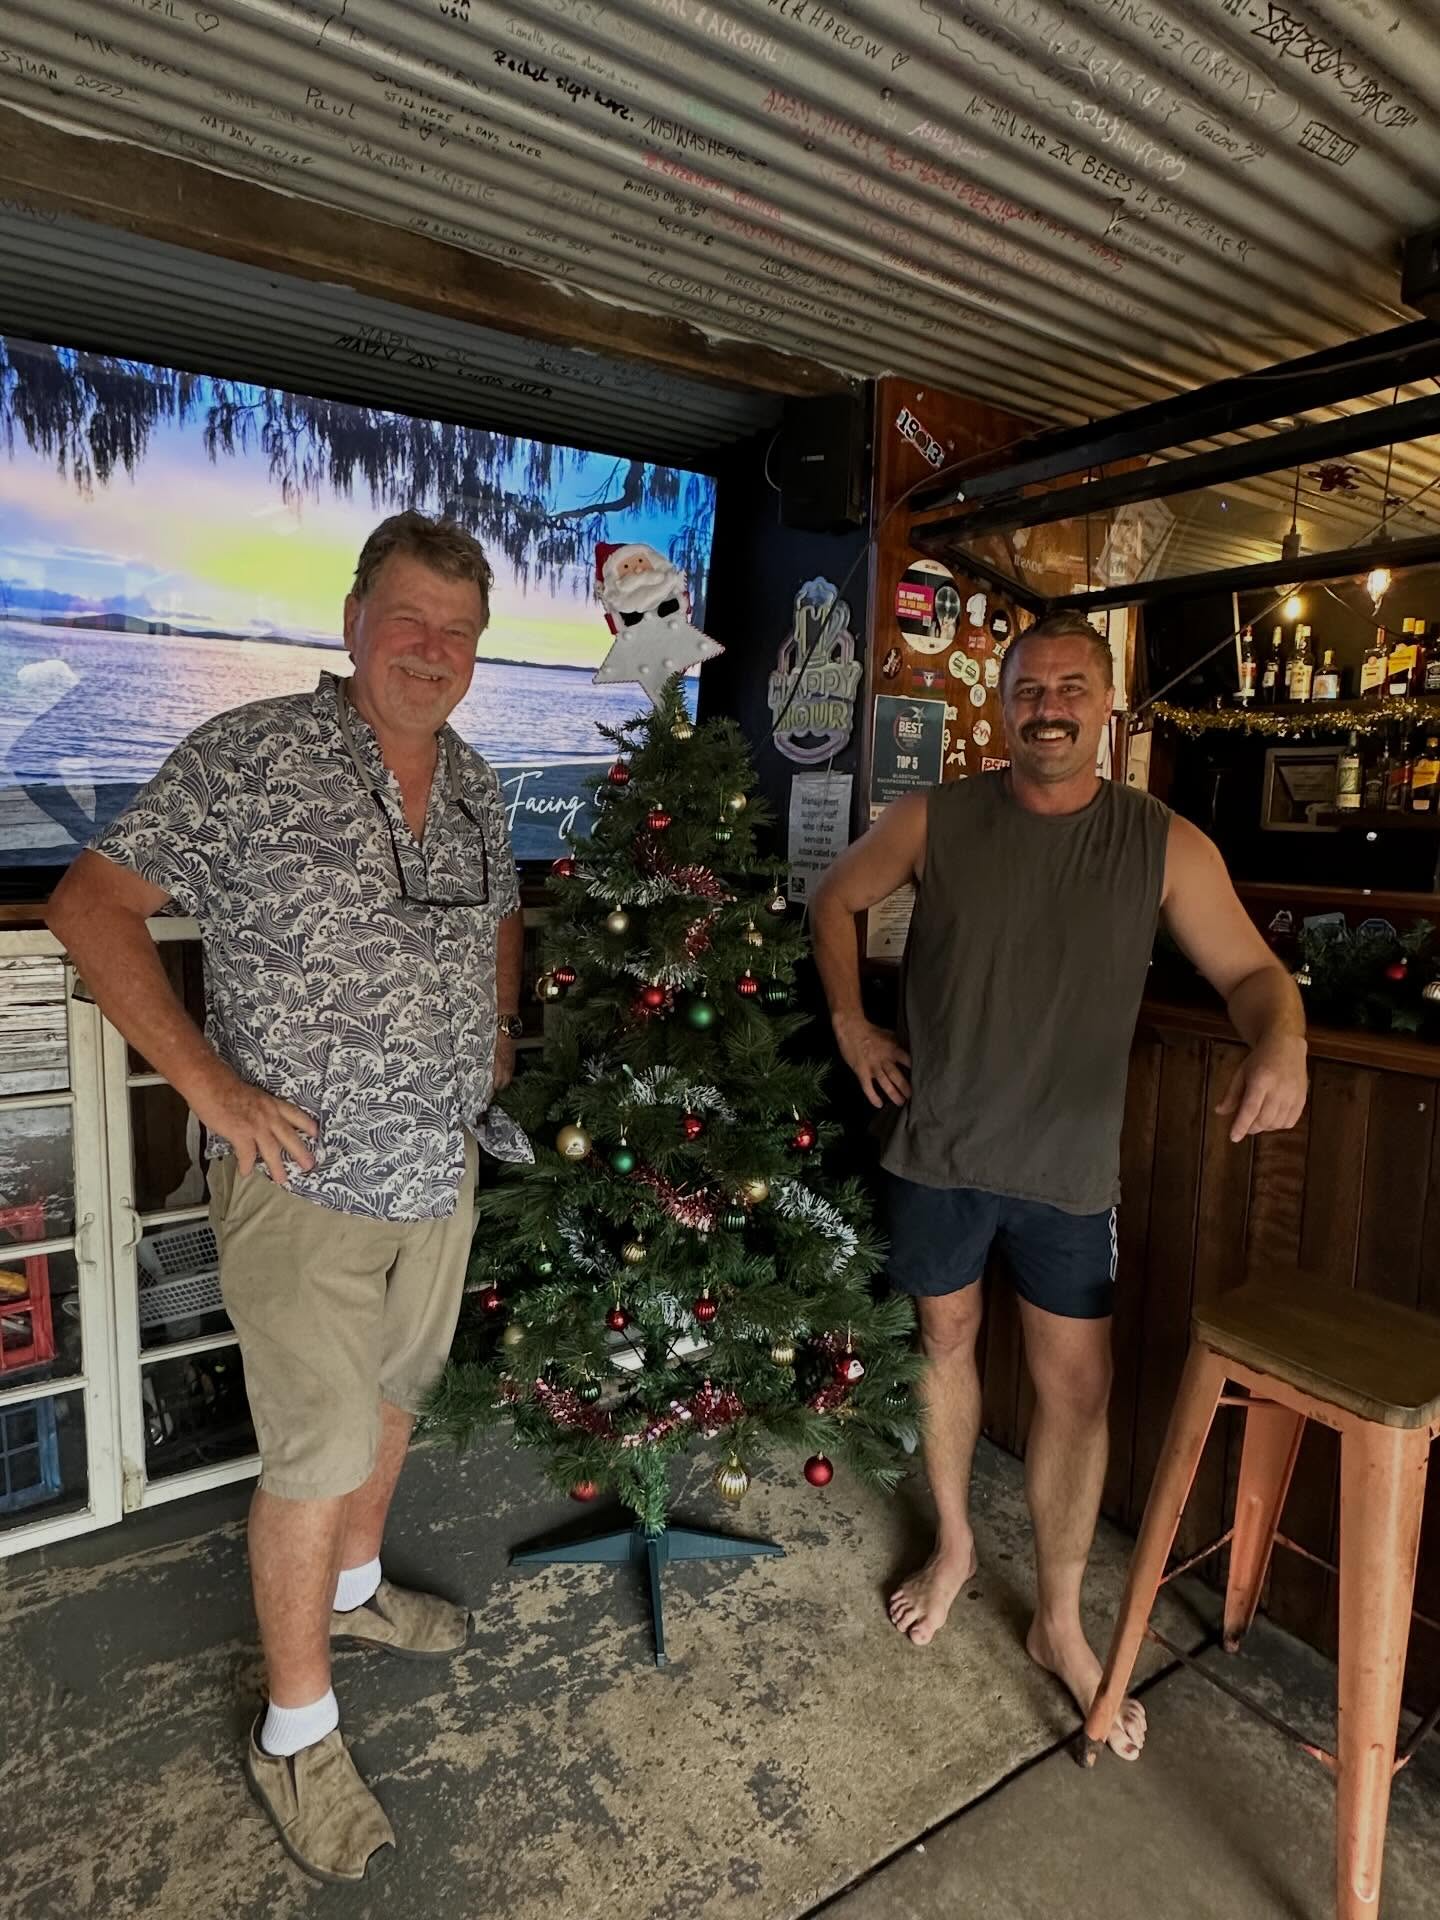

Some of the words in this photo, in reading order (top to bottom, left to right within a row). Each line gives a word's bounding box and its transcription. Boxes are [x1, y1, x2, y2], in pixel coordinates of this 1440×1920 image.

[706, 13, 777, 63] ALKOHAL
[809, 7, 883, 61] HARLOW
[492, 48, 549, 83] Rachel
[555, 77, 592, 103] slept
[305, 86, 361, 120] Paul
[384, 90, 414, 109] STILL
[420, 105, 455, 123] HERE
[474, 126, 501, 143] DAYS
[508, 139, 543, 158] LATER
[1081, 155, 1136, 193] BEERS
[769, 663, 860, 703] HAPPY
[775, 701, 849, 732] HOUR
[898, 720, 924, 735] BEST
[896, 755, 911, 769] TOP
[911, 756, 919, 770] 5
[502, 770, 586, 840] Facing
